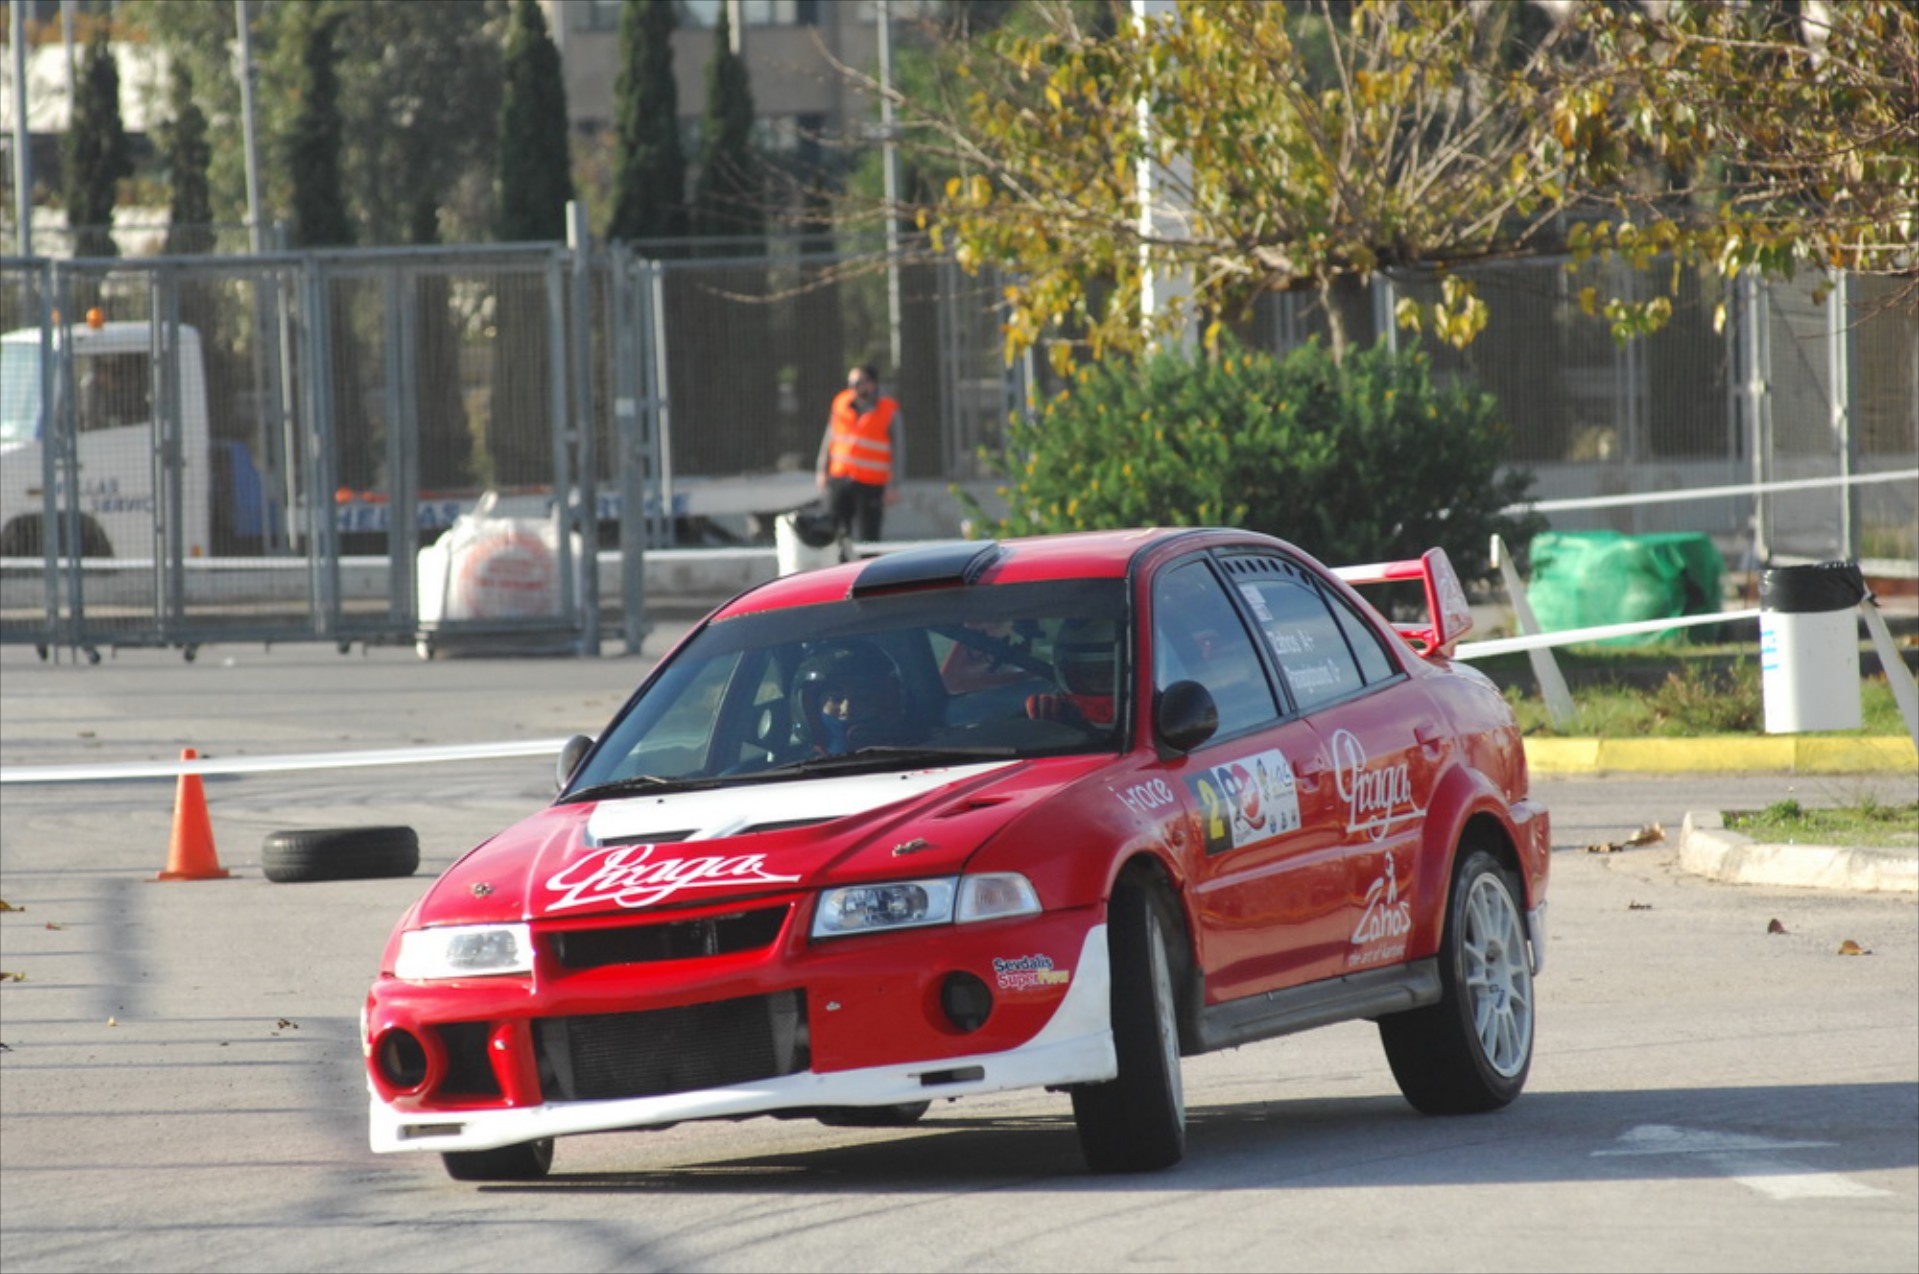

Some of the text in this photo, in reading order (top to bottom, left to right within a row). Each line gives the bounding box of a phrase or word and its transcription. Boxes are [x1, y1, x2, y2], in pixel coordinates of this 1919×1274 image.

[1197, 778, 1225, 839] 2
[1332, 728, 1426, 843] Praga
[544, 843, 802, 912] Praga
